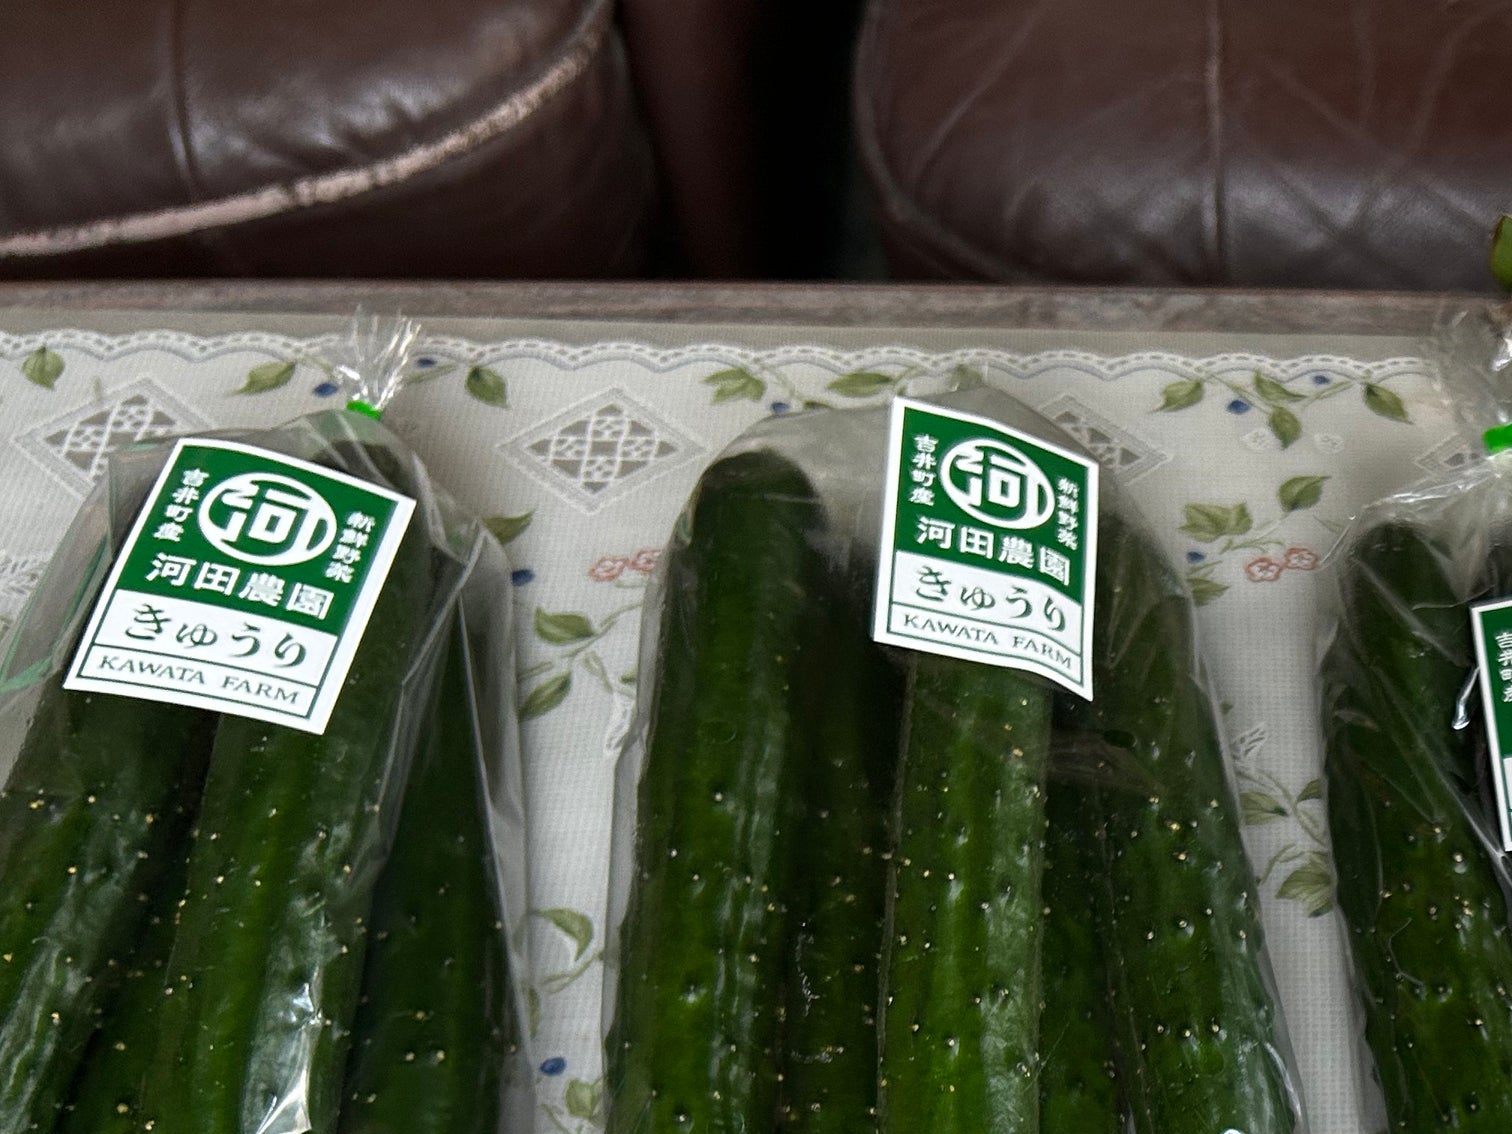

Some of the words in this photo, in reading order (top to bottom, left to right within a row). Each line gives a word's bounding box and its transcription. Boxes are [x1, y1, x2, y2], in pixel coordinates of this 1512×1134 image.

[909, 434, 938, 506] 吉井町産
[152, 467, 210, 543] 吉井町産
[1057, 477, 1079, 550] 新鮮野菜
[325, 511, 376, 583] 新鮮野菜
[916, 516, 1070, 585] 河田農園
[146, 553, 334, 620] 河田農園
[916, 565, 1065, 631] きゅうり
[125, 603, 306, 668] きゅうり
[904, 614, 998, 645] KAWATA
[1012, 636, 1072, 669] FARM
[98, 655, 205, 684] KAWATA
[222, 675, 299, 704] FARM
